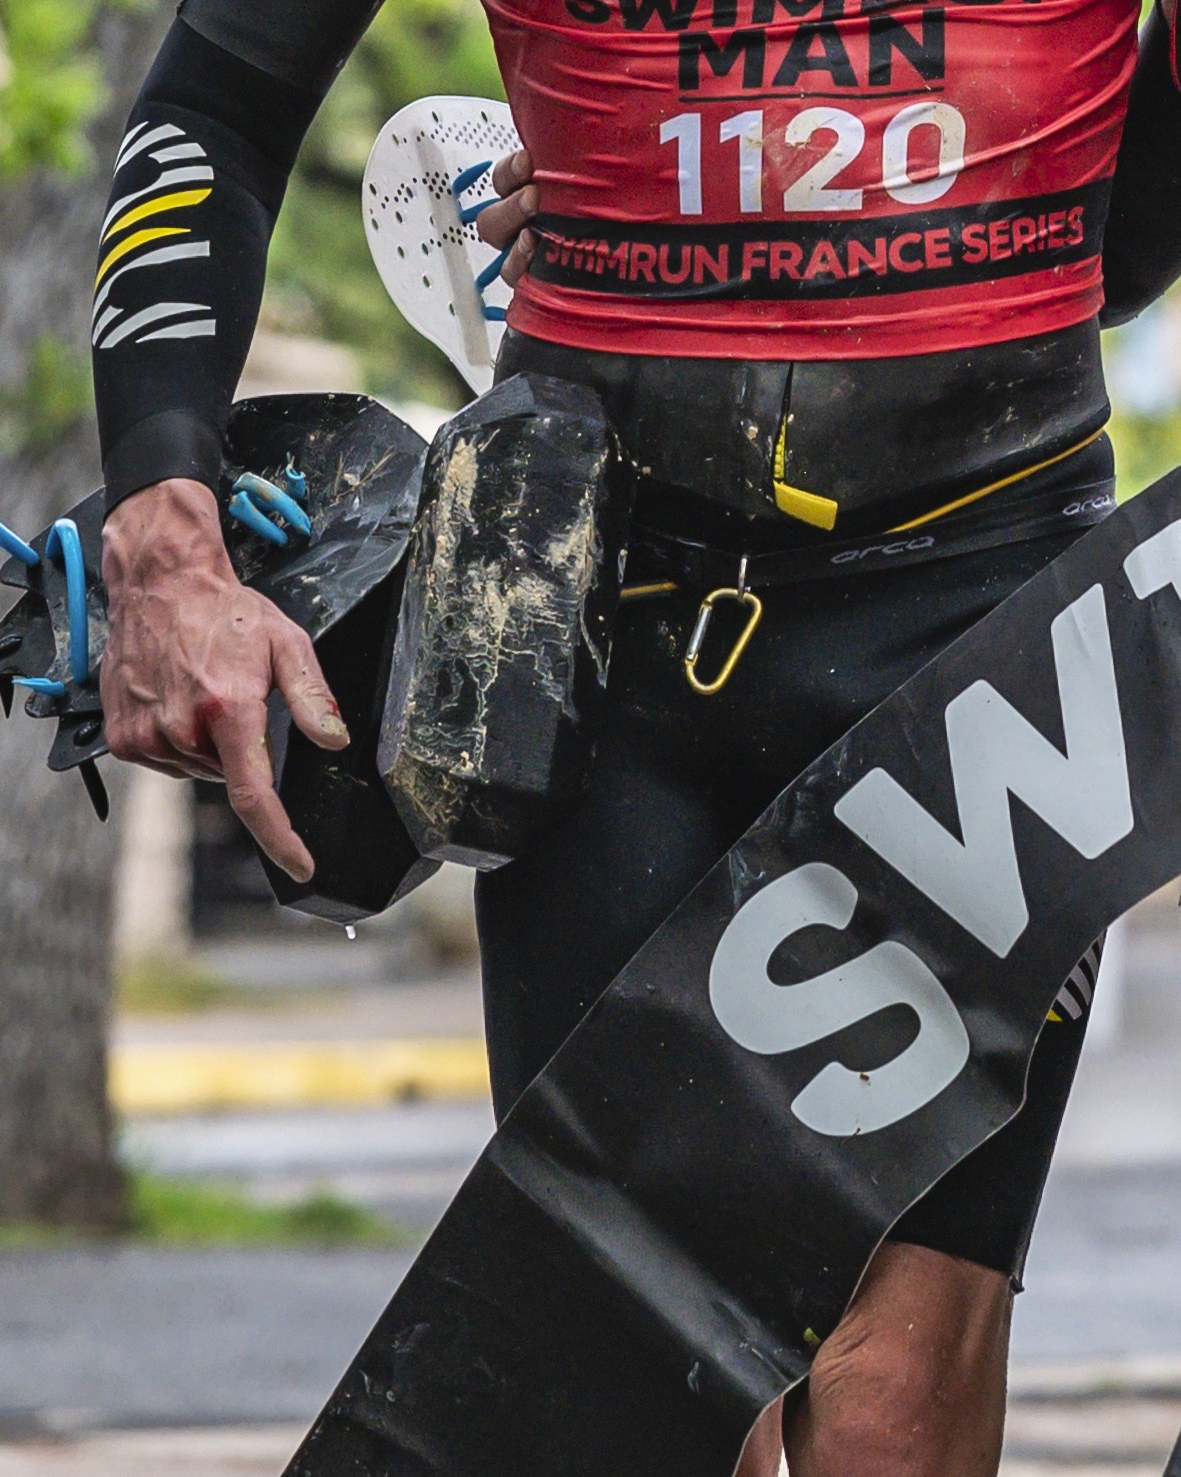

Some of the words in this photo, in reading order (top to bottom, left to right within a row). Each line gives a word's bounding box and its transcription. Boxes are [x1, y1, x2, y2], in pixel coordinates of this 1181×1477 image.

[678, 7, 946, 91] MAN
[659, 101, 967, 216] 1120
[544, 233, 729, 284] SWIMRUN
[741, 228, 953, 282] FRANCE
[961, 206, 1085, 264] SERIES
